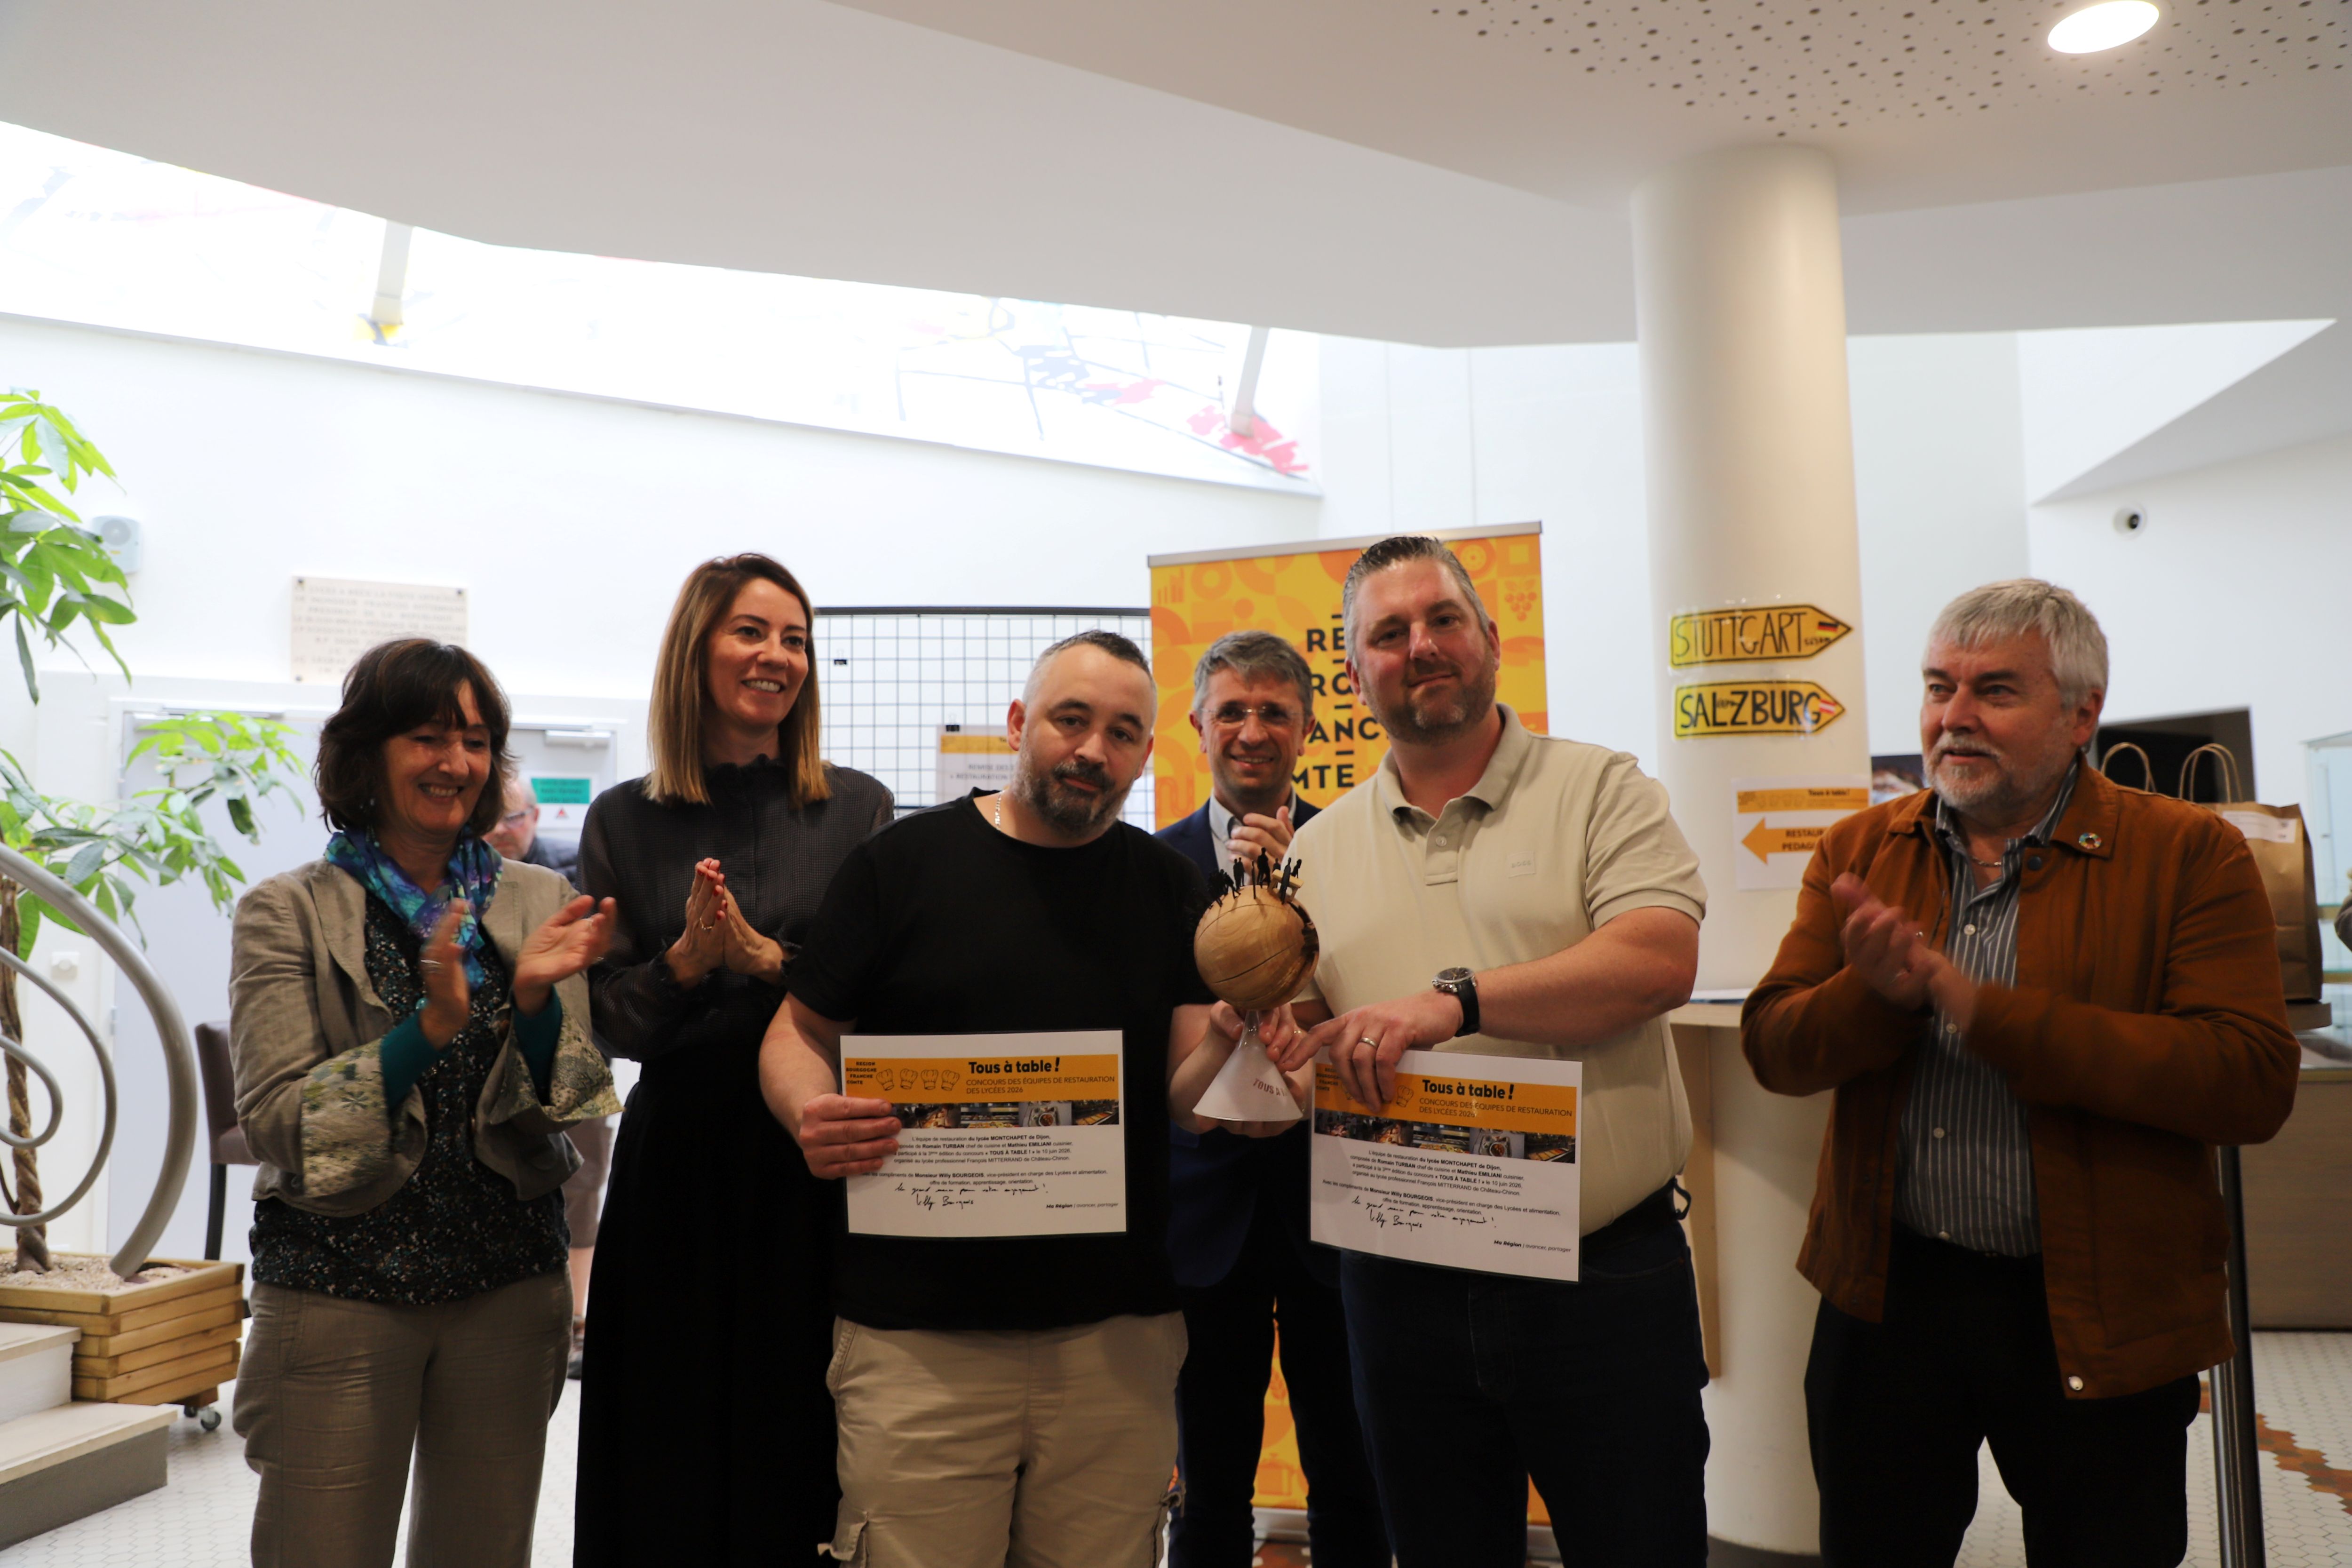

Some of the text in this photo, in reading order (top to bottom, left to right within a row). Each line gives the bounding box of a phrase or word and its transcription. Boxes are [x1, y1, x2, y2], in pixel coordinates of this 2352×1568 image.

[1676, 612, 1807, 657] STUTTGART
[1681, 690, 1821, 728] SALZBURG
[968, 1061, 1001, 1074] Tous
[1004, 1060, 1012, 1073] à
[1016, 1059, 1052, 1073] table
[1253, 1078, 1274, 1094] TOUS
[1422, 1079, 1453, 1094] Tous
[1456, 1082, 1465, 1095] à
[1469, 1084, 1505, 1099] table
[1419, 1098, 1458, 1107] CONCOURS
[1518, 1106, 1572, 1117] RESTAURATION
[1433, 1107, 1457, 1116] LYCÉES
